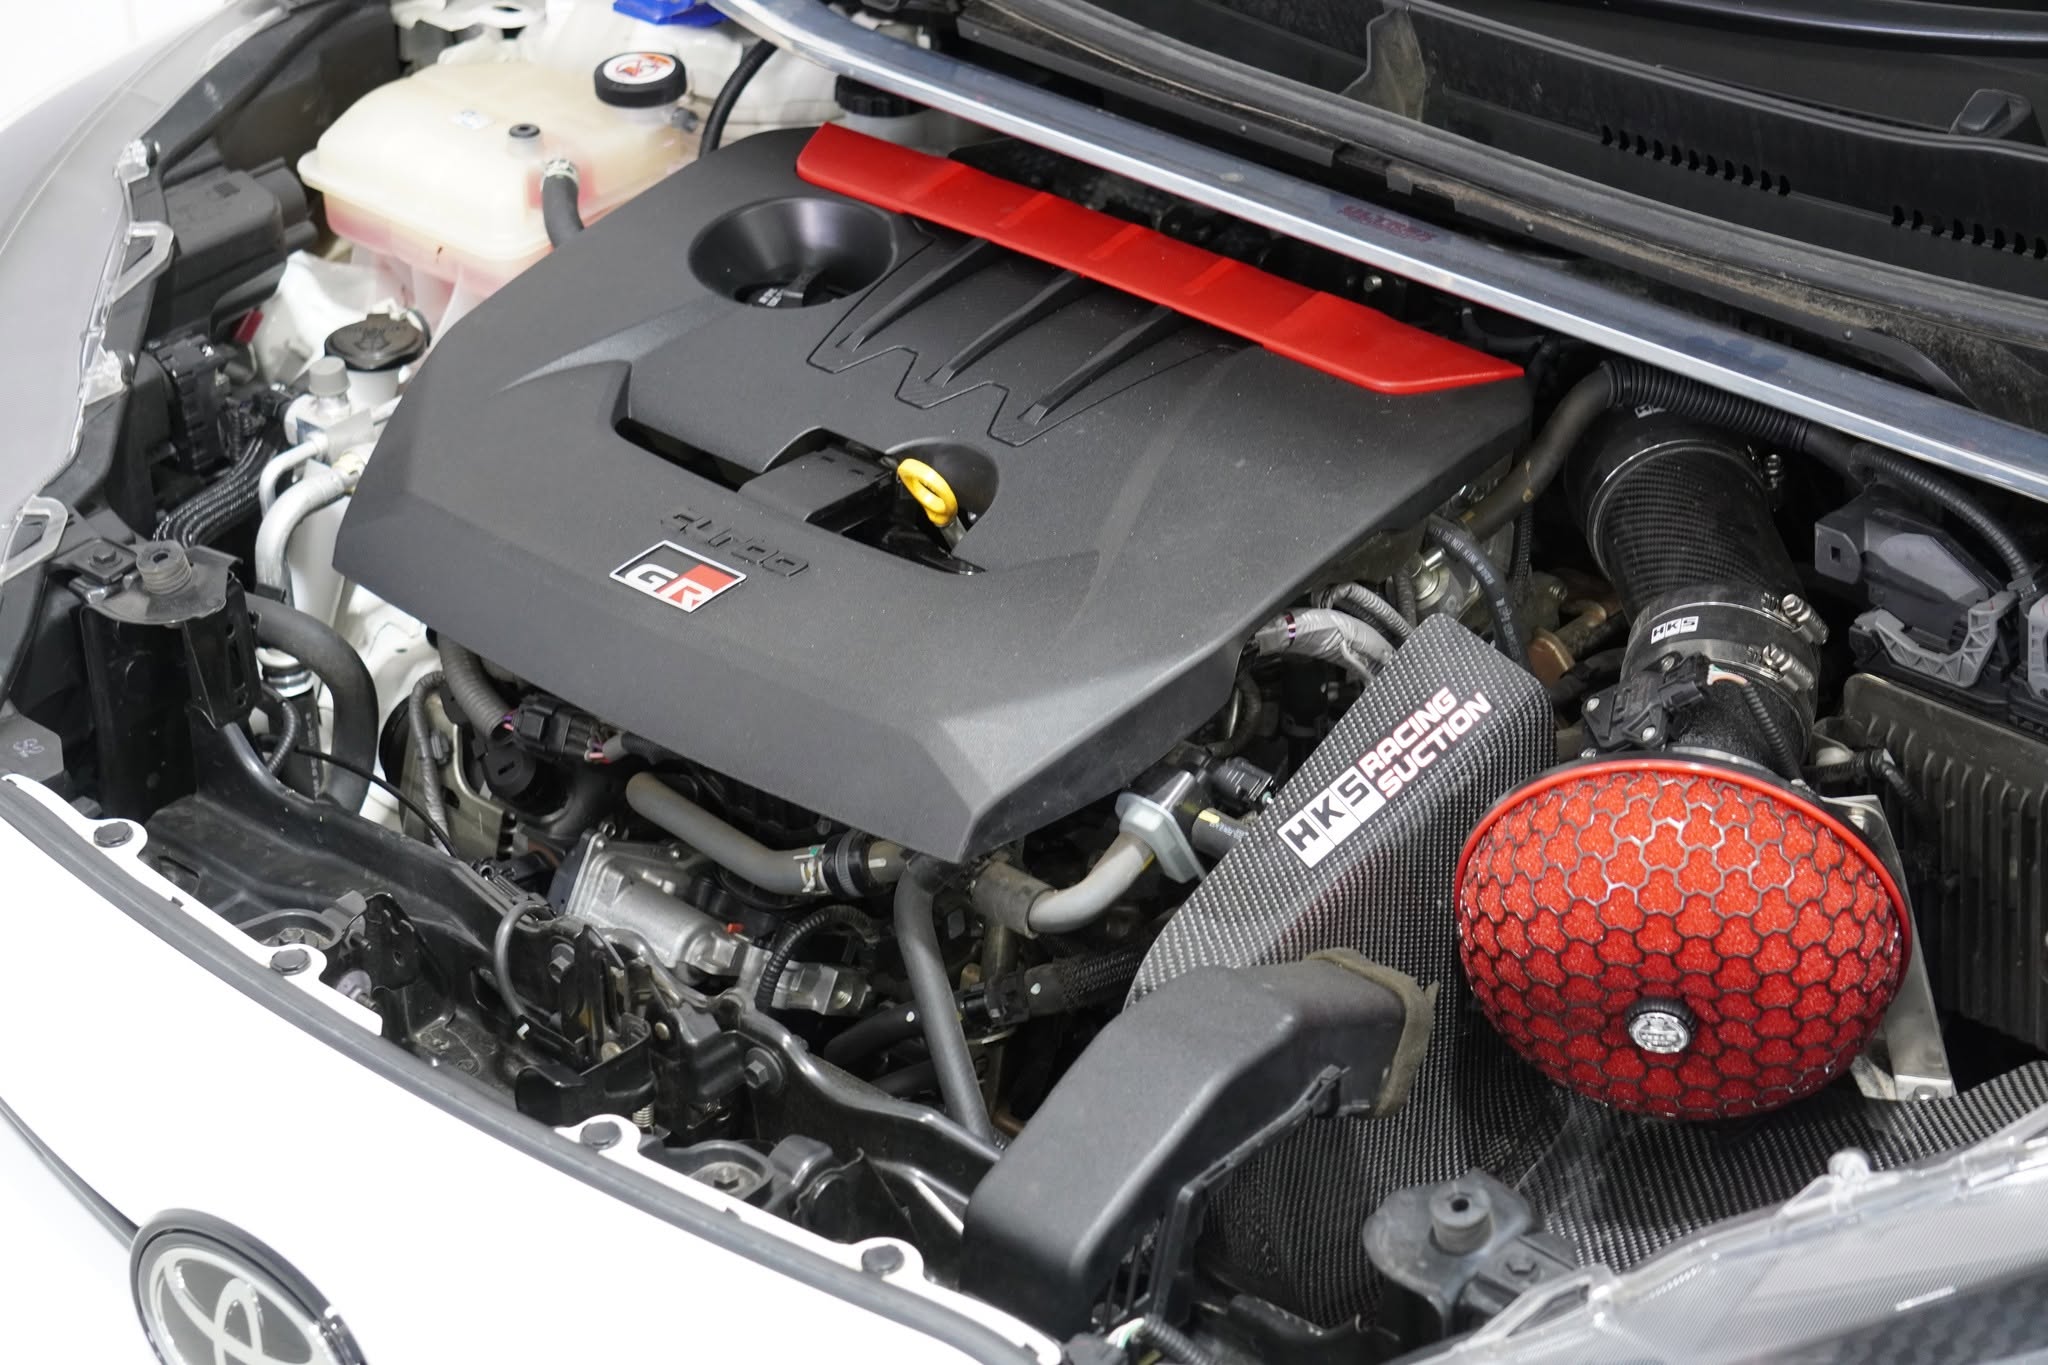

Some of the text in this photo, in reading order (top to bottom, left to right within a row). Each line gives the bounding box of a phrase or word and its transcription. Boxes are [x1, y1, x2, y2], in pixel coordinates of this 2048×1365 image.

[1652, 618, 1696, 639] HKS
[1358, 686, 1457, 780] RACING
[1377, 691, 1493, 799] SUCTION
[1283, 773, 1371, 852] HKS
